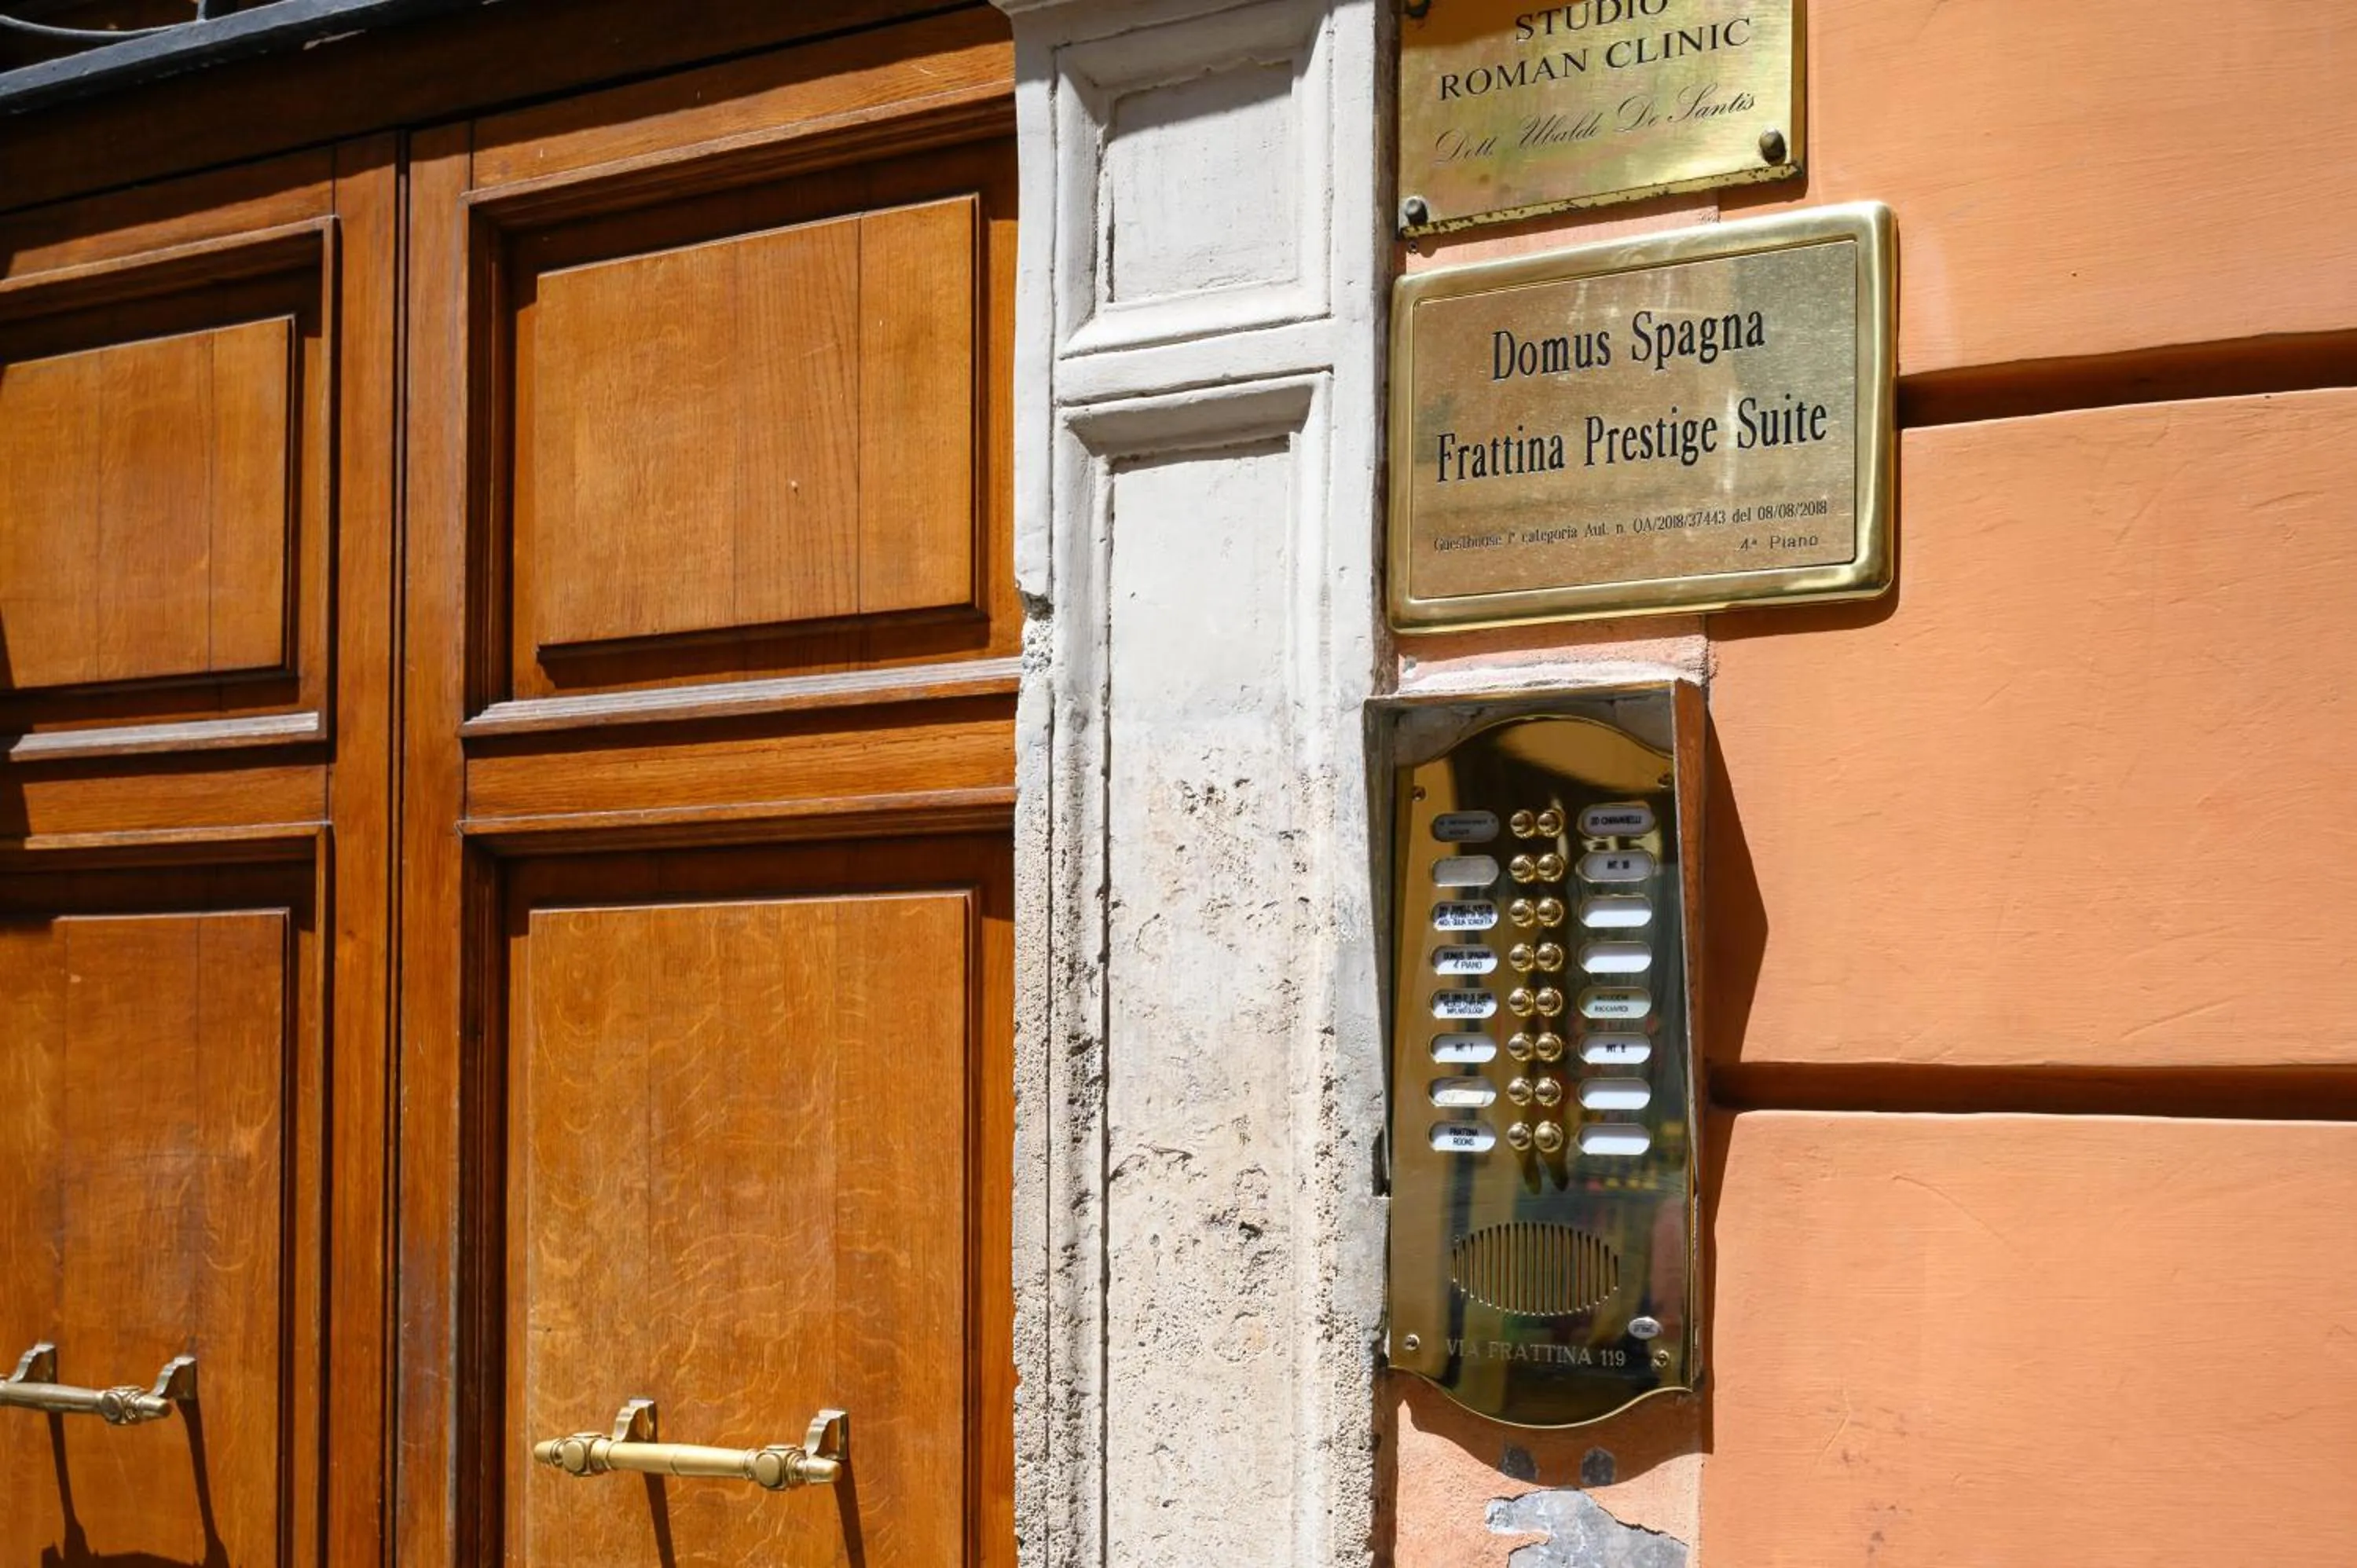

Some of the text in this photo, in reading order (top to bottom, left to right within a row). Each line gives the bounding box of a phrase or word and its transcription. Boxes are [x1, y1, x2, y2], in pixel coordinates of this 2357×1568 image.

[1515, 0, 1669, 41] STUDIO
[1439, 17, 1750, 101] ROMAN CLINIC
[1667, 82, 1755, 123] Santis
[1492, 310, 1765, 380] Domus Spagna
[1436, 393, 1827, 483] Frattina Prestige Suite
[1521, 525, 1578, 544] categoria
[1732, 507, 1752, 524] del
[1757, 500, 1827, 522] 08/08/2018
[1769, 535, 1820, 549] Piano
[1446, 1338, 1626, 1367] VIA FRATTINA 119
